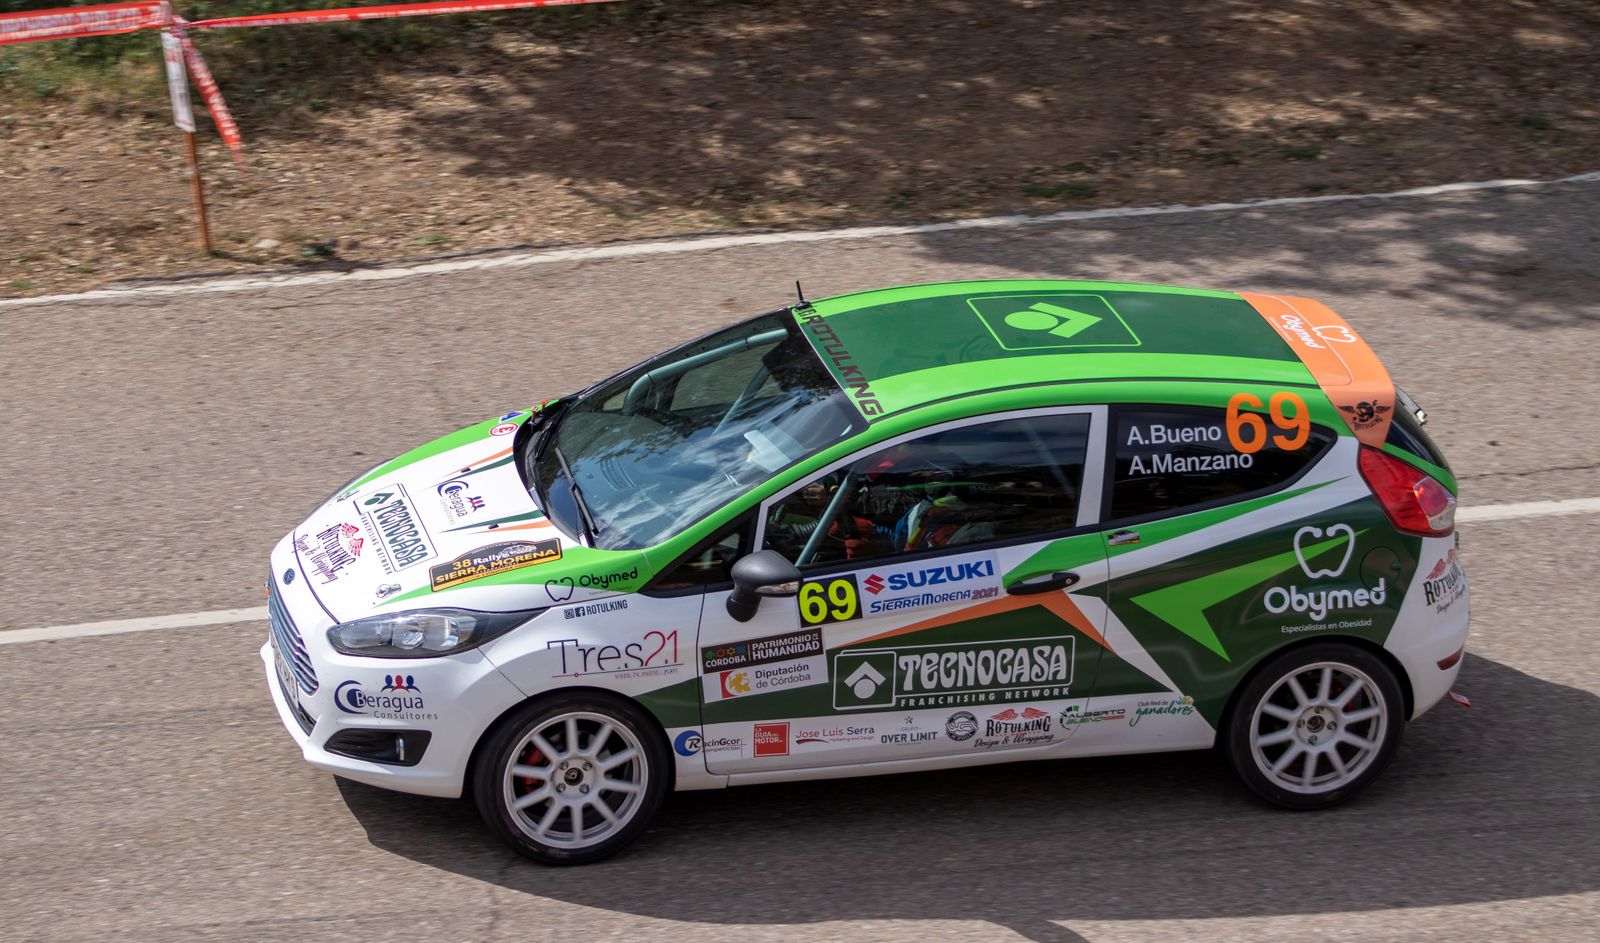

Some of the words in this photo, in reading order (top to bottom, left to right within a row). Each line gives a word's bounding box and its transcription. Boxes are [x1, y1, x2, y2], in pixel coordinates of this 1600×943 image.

[802, 314, 884, 416] ROTULKING
[1225, 391, 1311, 454] 69
[1126, 424, 1222, 446] A.Bueno
[1128, 452, 1254, 476] A.Manzano
[373, 498, 428, 568] TECNOCASA
[436, 564, 488, 583] SIERRA
[490, 549, 556, 569] MORENA
[452, 558, 472, 571] 38
[579, 566, 638, 589] Obymed
[888, 560, 994, 591] SUZUKI
[799, 578, 858, 624] 69
[971, 586, 999, 600] 2021
[1264, 578, 1386, 621] Obymed
[586, 599, 629, 616] ROTULKING
[1281, 622, 1327, 634] Especialistas
[1339, 618, 1372, 629] Obesidad
[752, 634, 812, 651] PATRIMONIO
[752, 641, 820, 660] HUMANIDAD
[755, 664, 810, 679] Diputación
[898, 645, 1068, 691] TECNOCASA
[756, 681, 768, 689] de
[770, 674, 811, 686] Córdoba
[355, 690, 424, 713] Beragua
[901, 692, 996, 707] FRANCHISING
[1005, 686, 1071, 700] NETWORK
[373, 710, 439, 720] Consultores
[1129, 700, 1195, 727] ganadores
[796, 730, 820, 738] Jose
[822, 728, 844, 737] Luis
[846, 726, 875, 736] Serra
[985, 716, 1051, 737] ROTULKING
[881, 733, 907, 744] OVER
[910, 731, 938, 742] LIMIT
